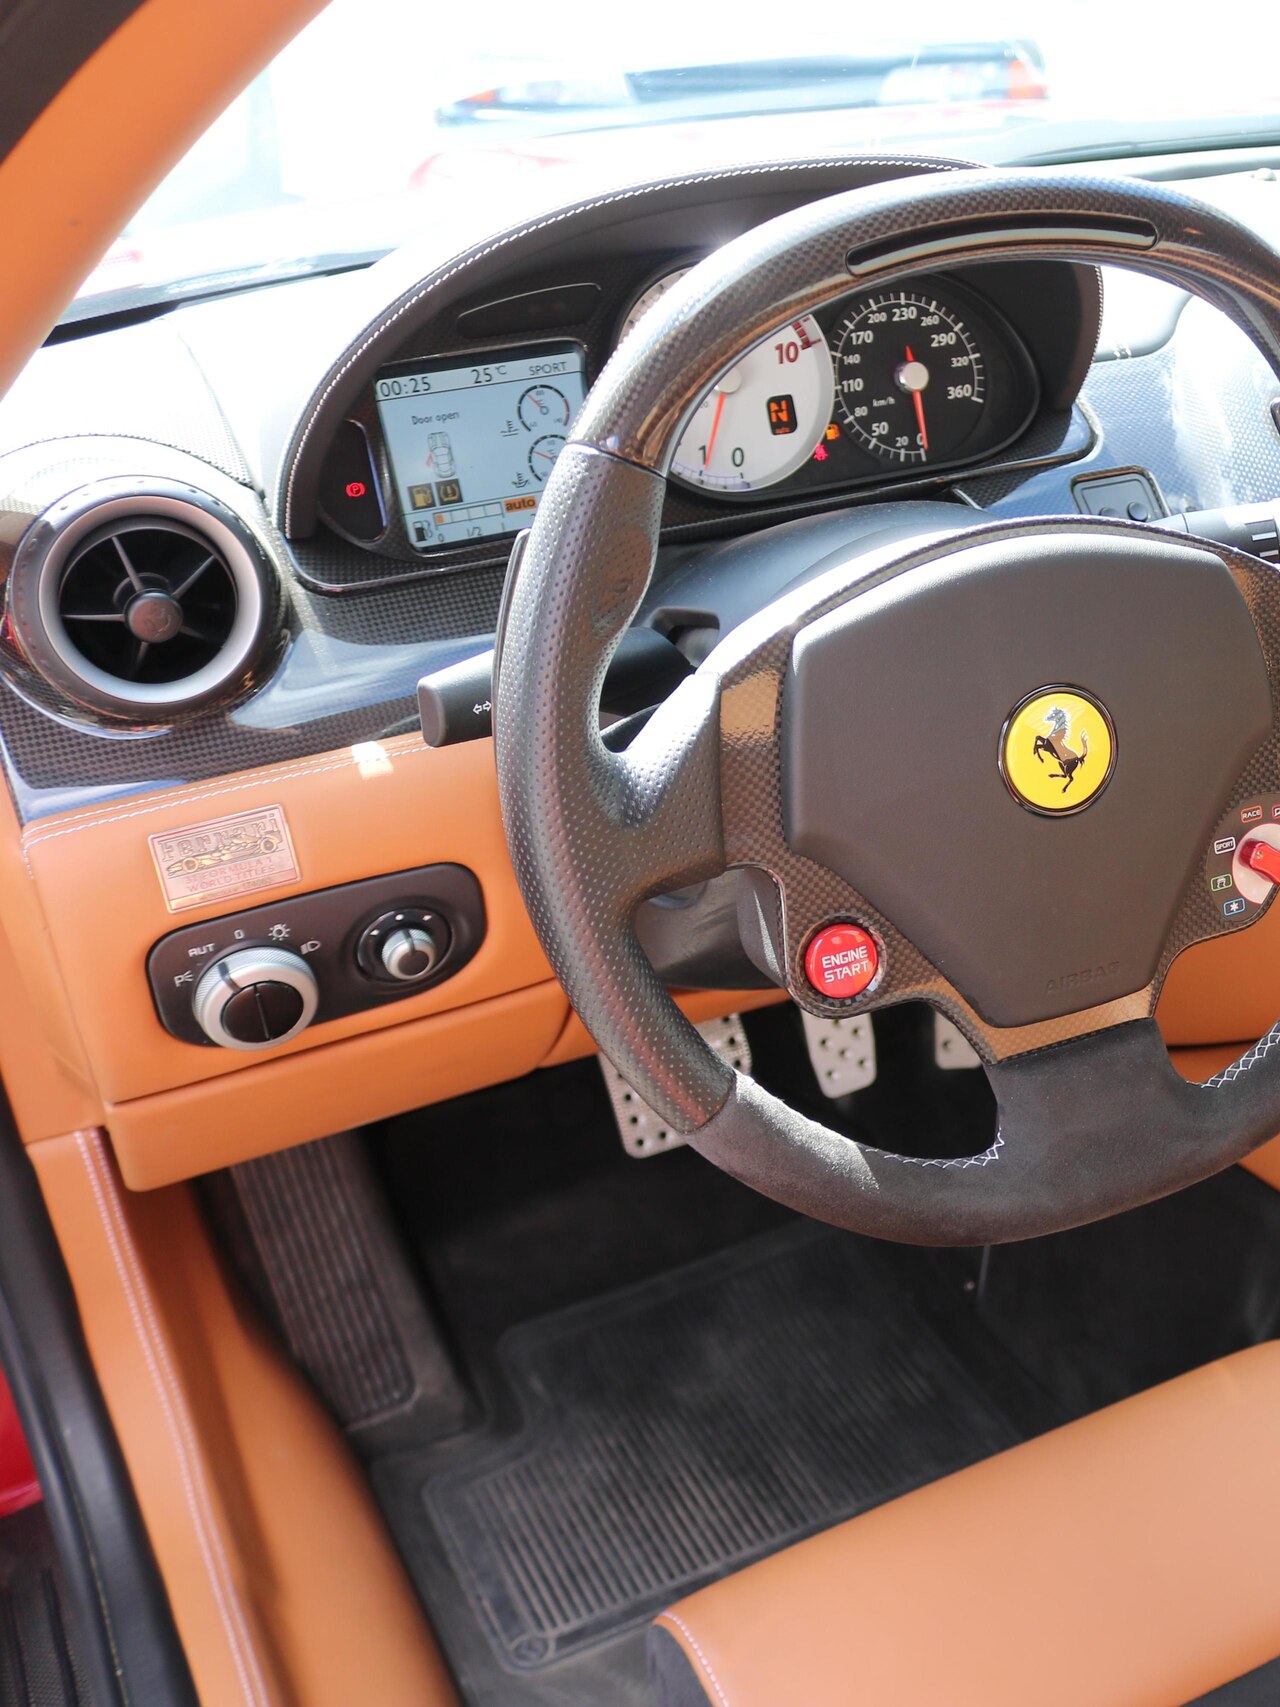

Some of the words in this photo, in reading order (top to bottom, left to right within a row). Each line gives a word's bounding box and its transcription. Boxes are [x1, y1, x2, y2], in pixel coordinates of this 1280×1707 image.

[867, 312, 888, 324] 200
[892, 306, 918, 322] 230
[920, 315, 940, 327] 260
[850, 330, 874, 345] 170
[930, 332, 957, 347] 290
[775, 341, 799, 364] 10
[843, 354, 861, 365] 140
[528, 361, 567, 376] SPORT
[951, 356, 969, 367] 320
[380, 376, 431, 397] 00:25
[842, 378, 864, 393] 110
[947, 384, 972, 399] 360
[872, 396, 895, 407] km/h
[411, 415, 433, 425] Door
[435, 411, 460, 424] open
[769, 400, 789, 423] N
[854, 406, 868, 417] 80
[871, 421, 889, 436] 50
[895, 436, 909, 447] 20
[698, 444, 707, 465] 1
[731, 447, 744, 467] 0
[504, 498, 537, 511] auto
[1241, 808, 1261, 820] RACE
[1215, 840, 1235, 851] SPORT
[186, 876, 233, 893] WORLD
[236, 864, 277, 882] TITLES
[187, 943, 215, 957] AUT
[821, 945, 868, 969] ENGINE
[823, 959, 870, 983] START
[1046, 960, 1120, 995] AIRBAG
